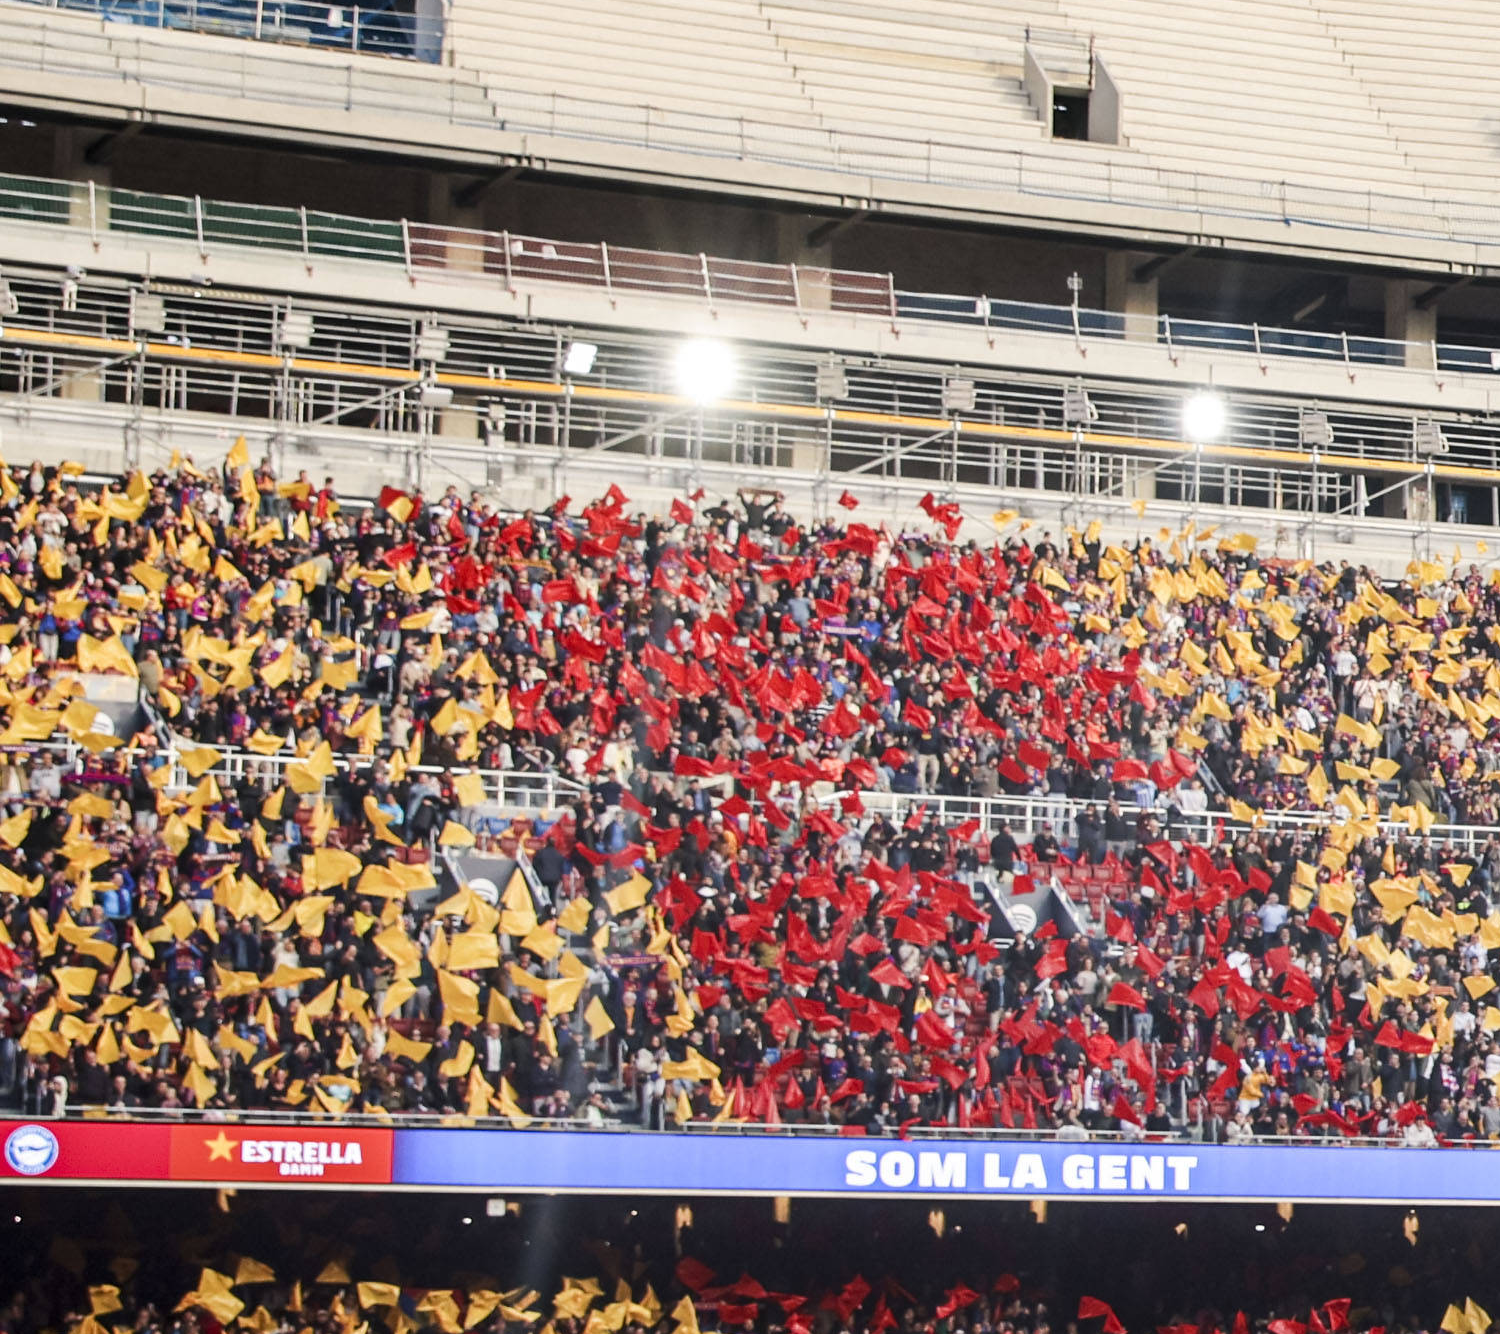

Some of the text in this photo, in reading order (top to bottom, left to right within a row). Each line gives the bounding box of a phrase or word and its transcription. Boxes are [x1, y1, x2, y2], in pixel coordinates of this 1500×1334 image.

[242, 1140, 362, 1164] ESTRELLA
[279, 1162, 324, 1176] DAMM
[845, 1150, 1197, 1191] SOM LA GENT
